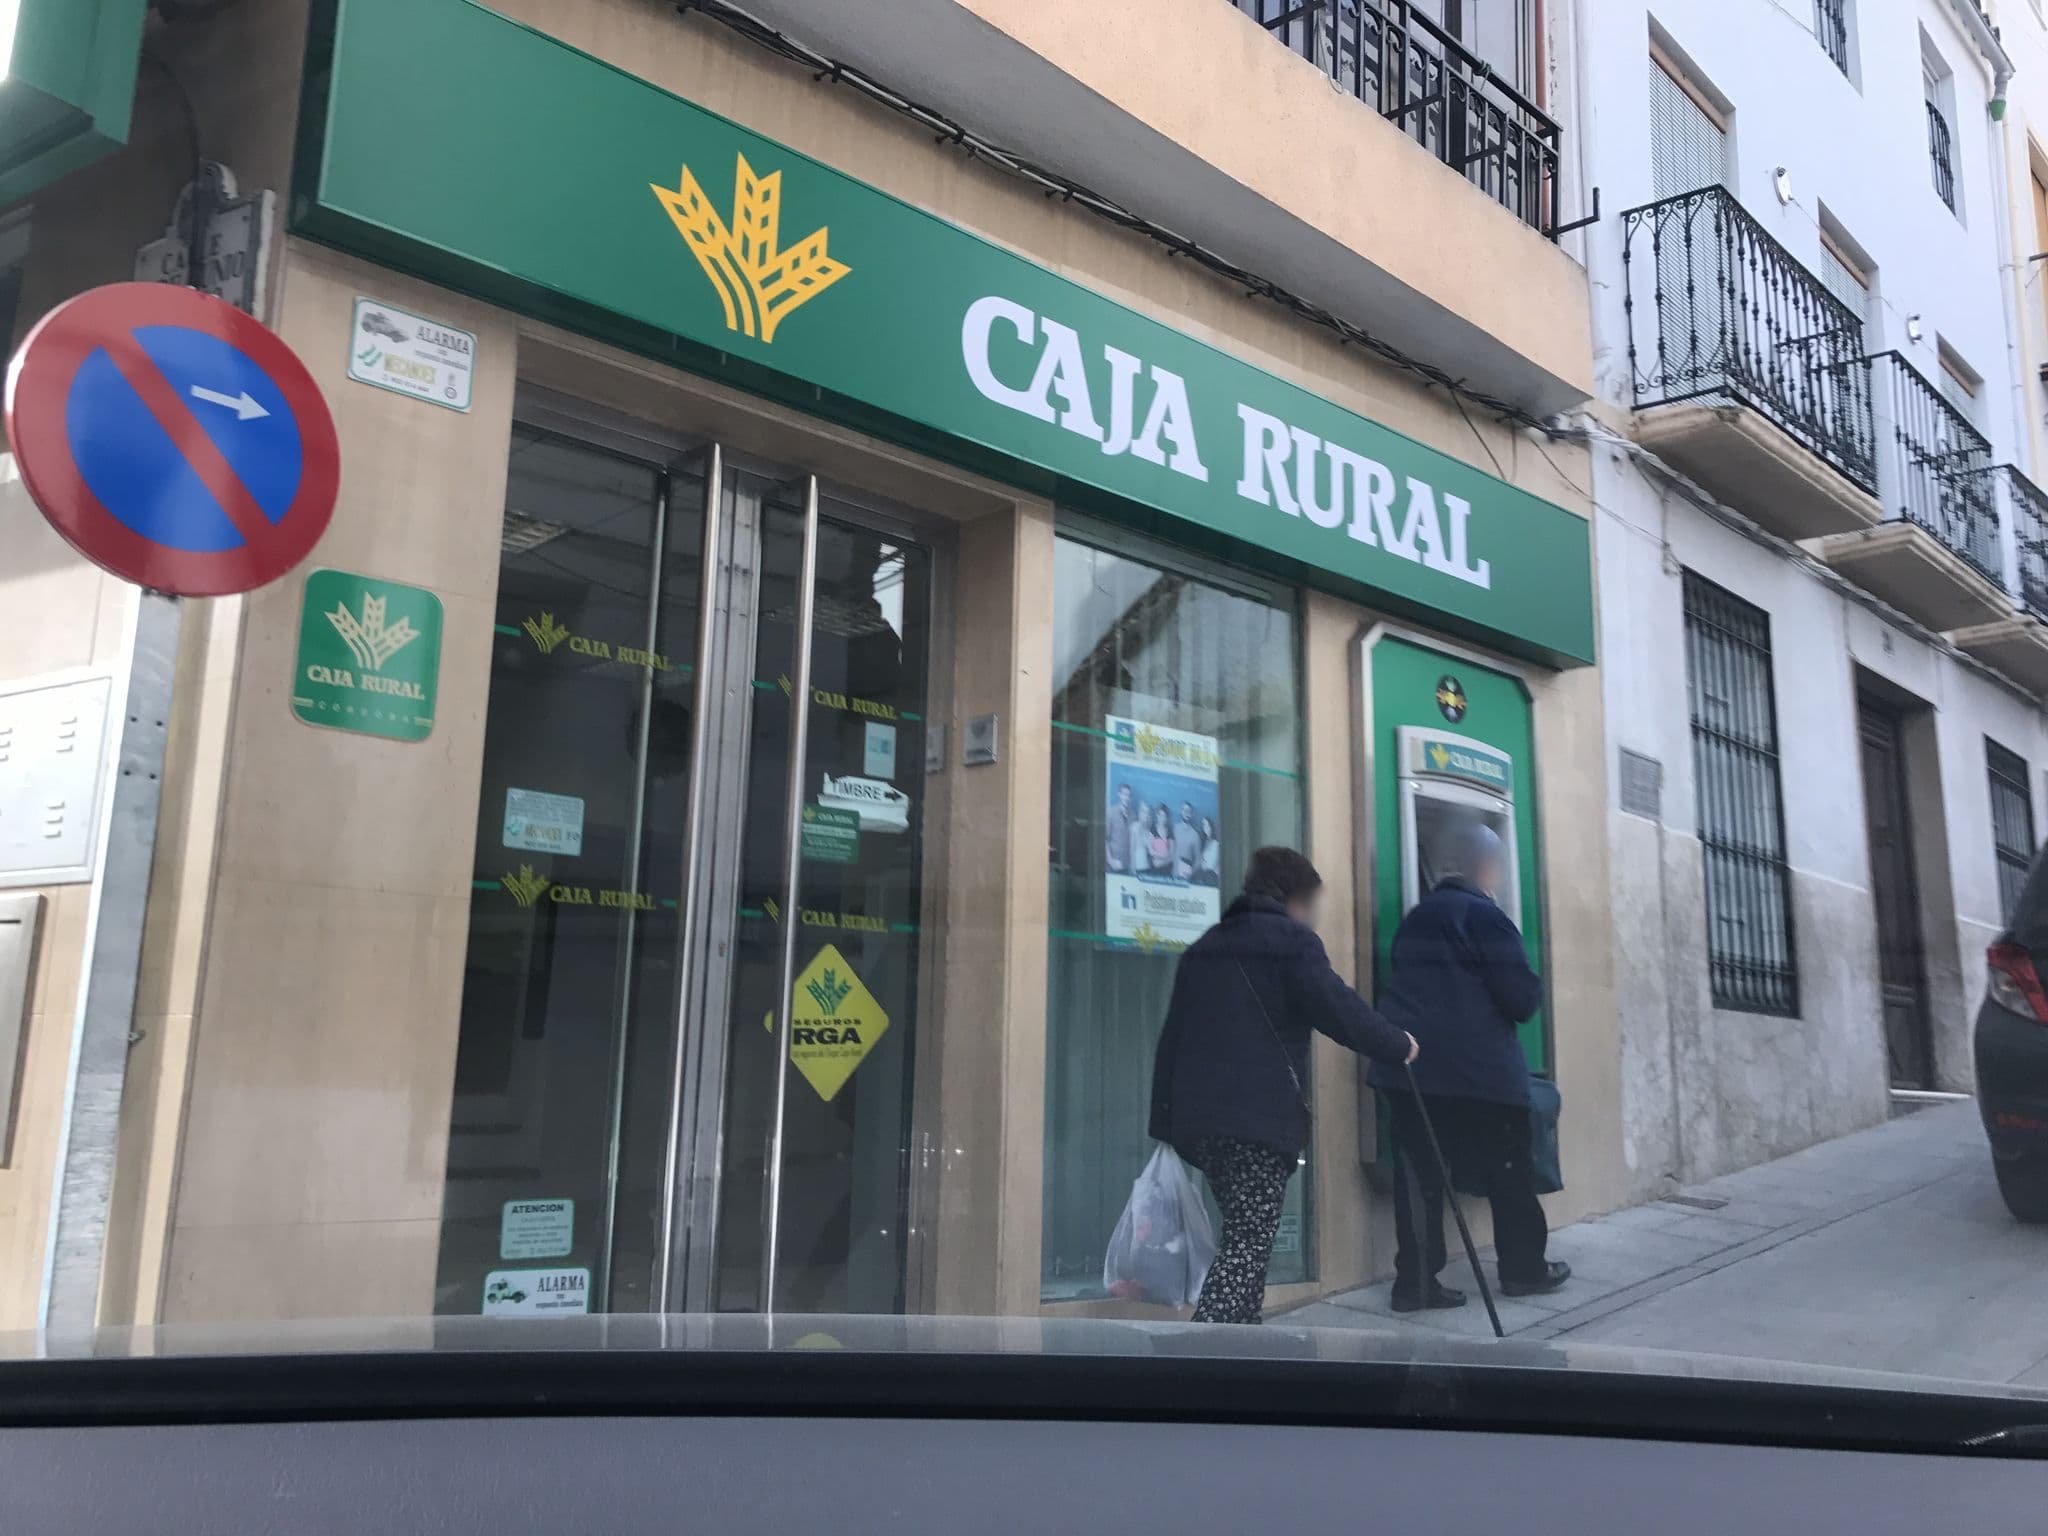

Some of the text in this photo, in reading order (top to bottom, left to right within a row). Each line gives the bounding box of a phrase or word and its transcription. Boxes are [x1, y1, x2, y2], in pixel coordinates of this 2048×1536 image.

[416, 326, 470, 353] ALARMA
[962, 296, 1491, 590] CAJA RURAL
[617, 645, 673, 671] RURAL
[307, 664, 425, 700] CAJA RURAL
[852, 697, 898, 720] RURAL
[831, 780, 884, 801] TIMBRE
[598, 889, 656, 910] RURAL
[841, 914, 888, 933] RURAL
[793, 1018, 862, 1027] SEGUROS
[793, 1027, 862, 1046] RGA
[512, 1203, 564, 1214] ATENCION
[536, 1275, 585, 1292] ALARMA
